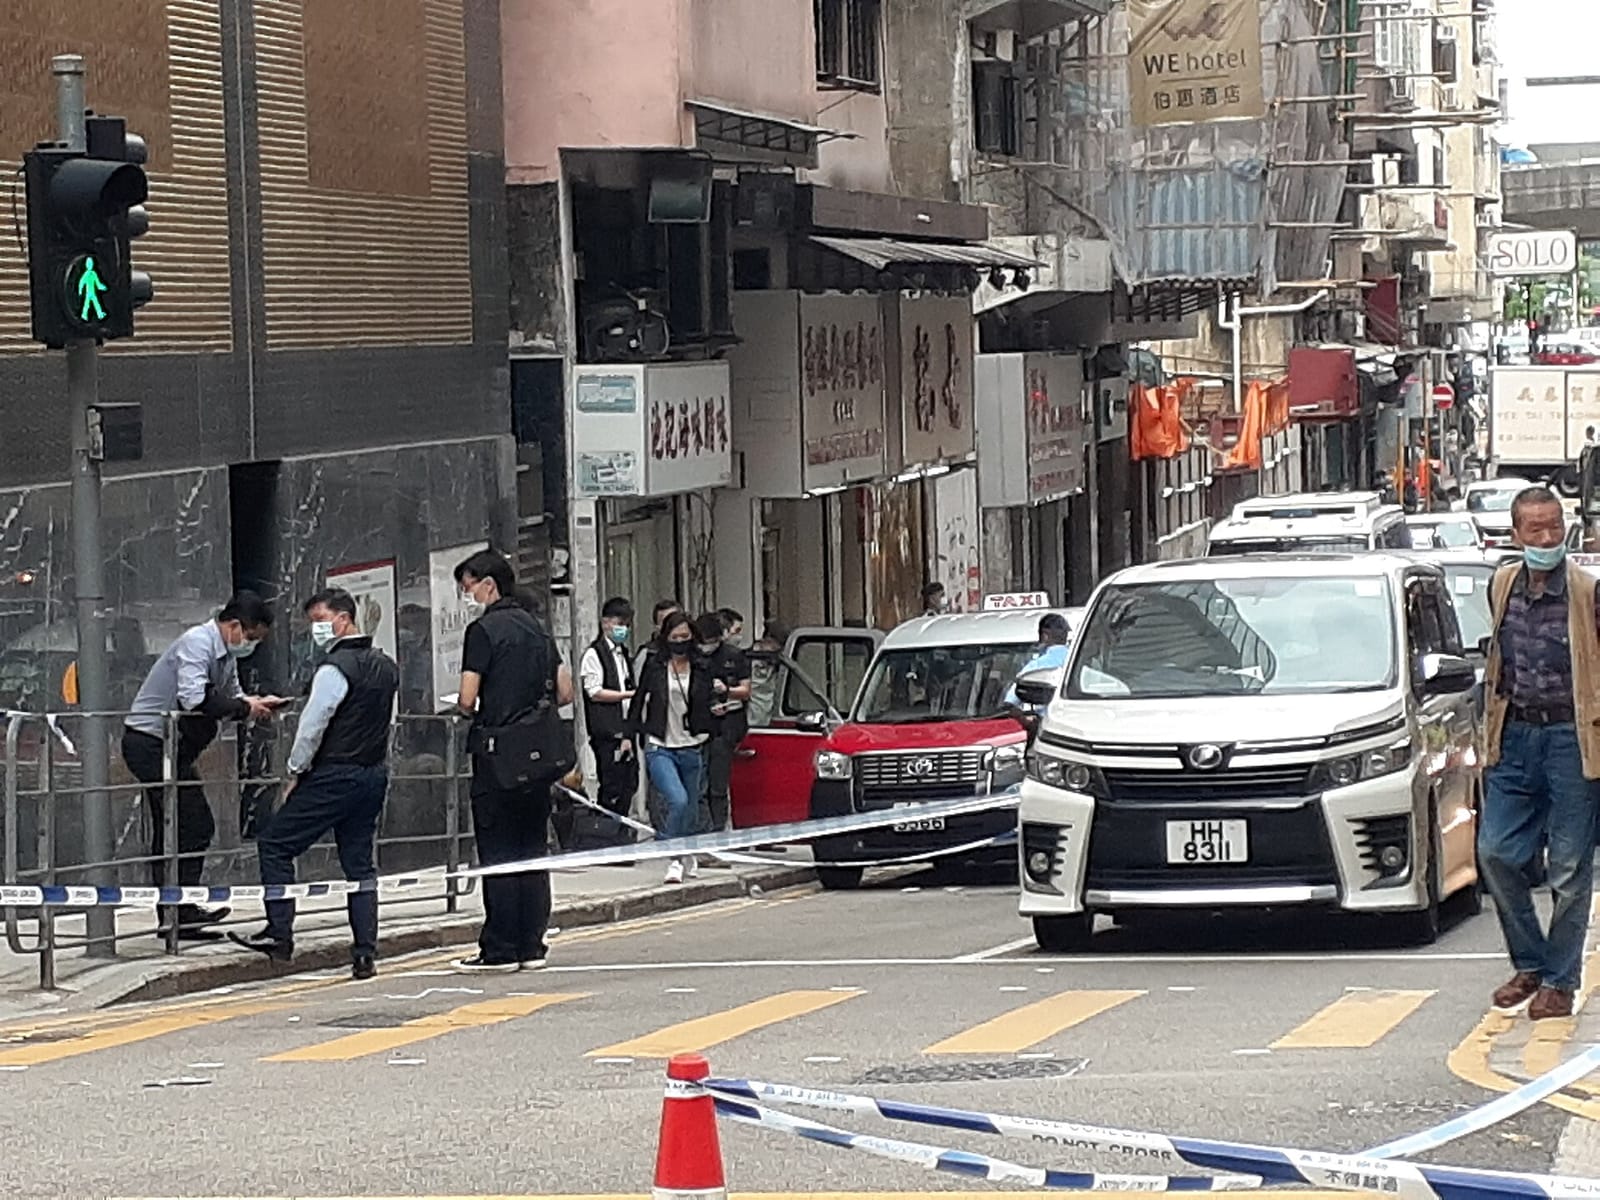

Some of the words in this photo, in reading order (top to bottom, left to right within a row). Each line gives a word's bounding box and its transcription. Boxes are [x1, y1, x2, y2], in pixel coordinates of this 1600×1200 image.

[1143, 53, 1179, 75] WE
[1186, 48, 1246, 71] hotel
[1497, 237, 1567, 267] SOLO
[989, 594, 1042, 608] TAXI
[1191, 822, 1223, 842] HH
[1184, 841, 1230, 861] 8311
